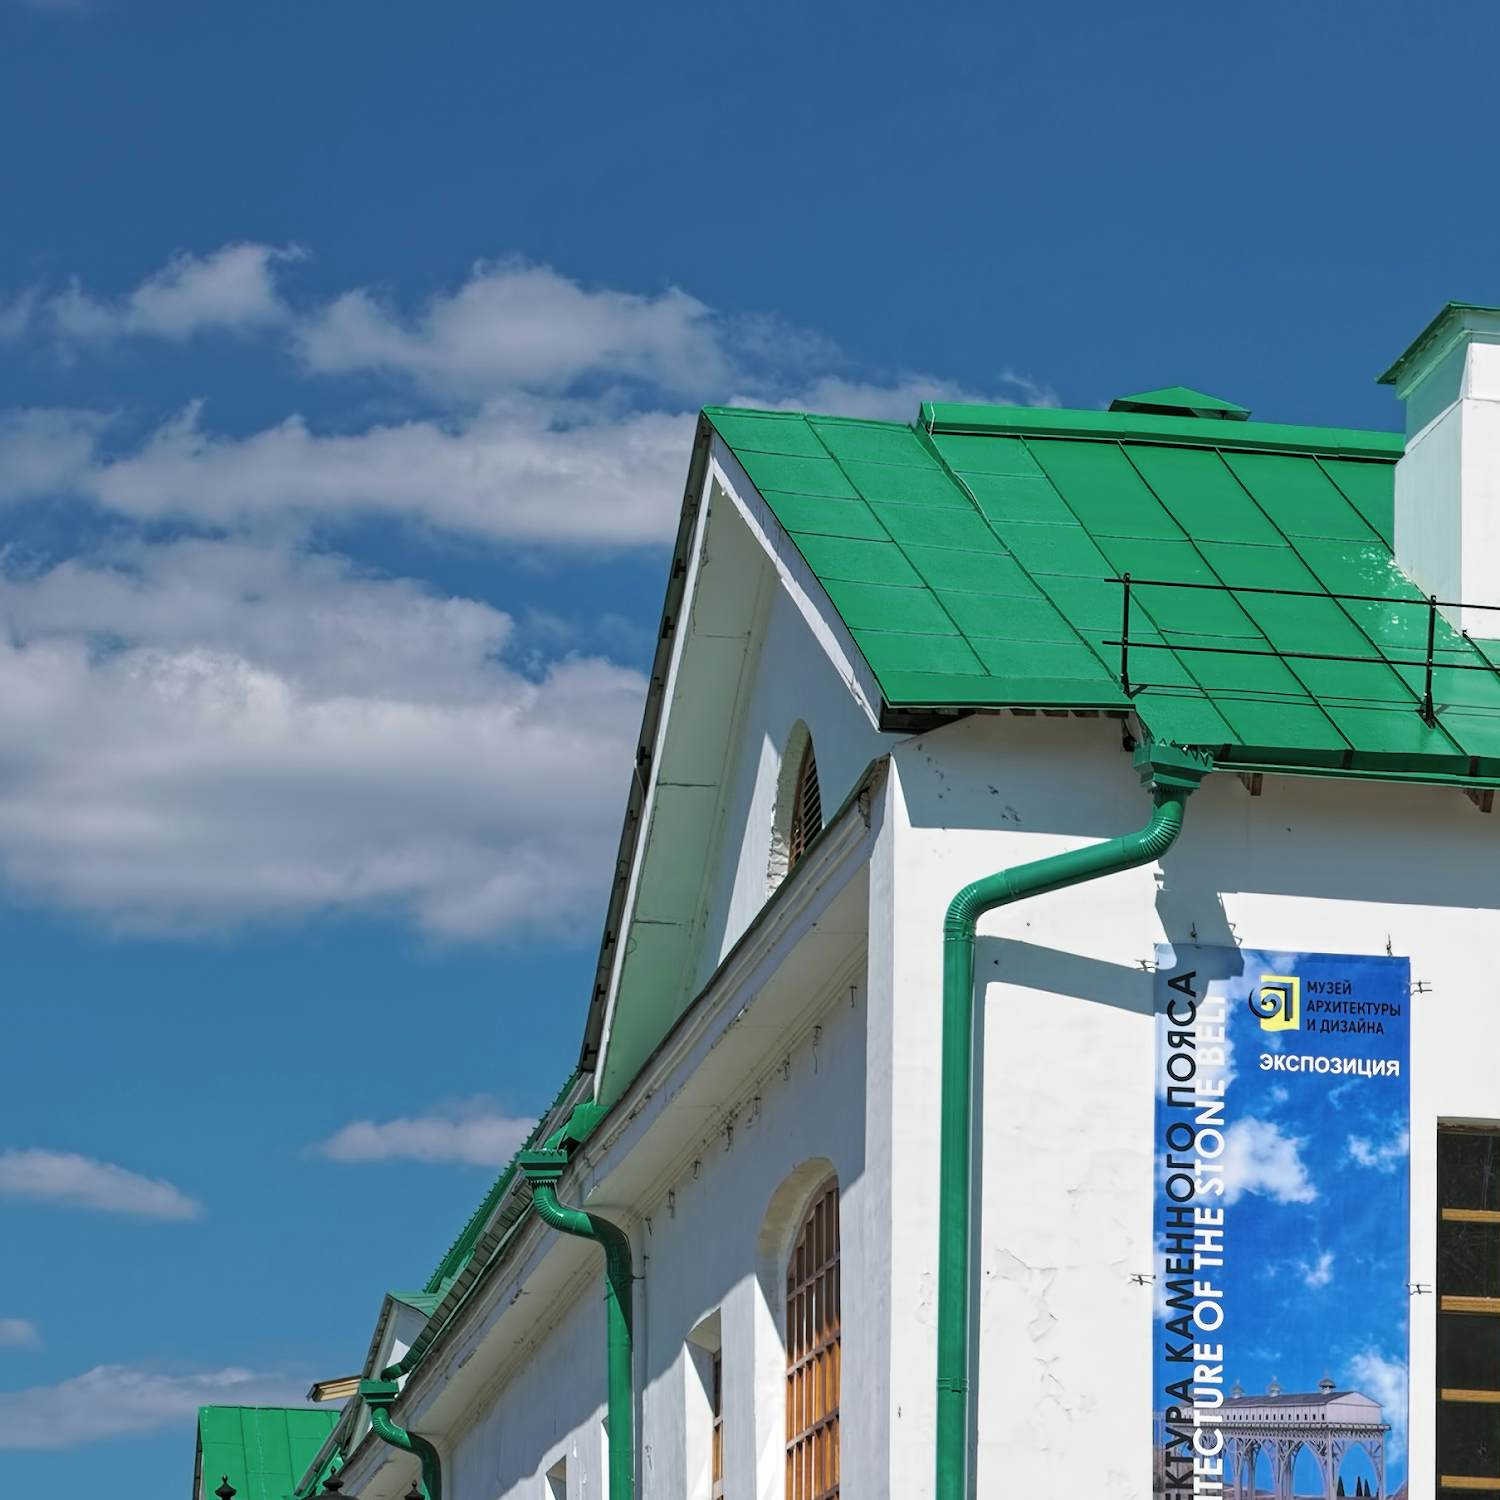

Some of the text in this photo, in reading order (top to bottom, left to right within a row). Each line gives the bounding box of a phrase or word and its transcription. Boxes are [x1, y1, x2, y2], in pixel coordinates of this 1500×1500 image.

[1306, 1000, 1401, 1017] АРХИТЕКТУРЫ
[1307, 979, 1352, 995] МУЗЕЙ
[1166, 971, 1197, 1108] ПОЯСА
[1306, 1017, 1384, 1034] И ДИЗАЙНА
[1259, 1053, 1400, 1078] ЭКСПОЗИЦИЯ
[1194, 1079, 1225, 1197] STONE
[1165, 1123, 1196, 1363] КАМЕННОГО
[1194, 1207, 1225, 1270] THE
[1193, 1281, 1225, 1332] OF
